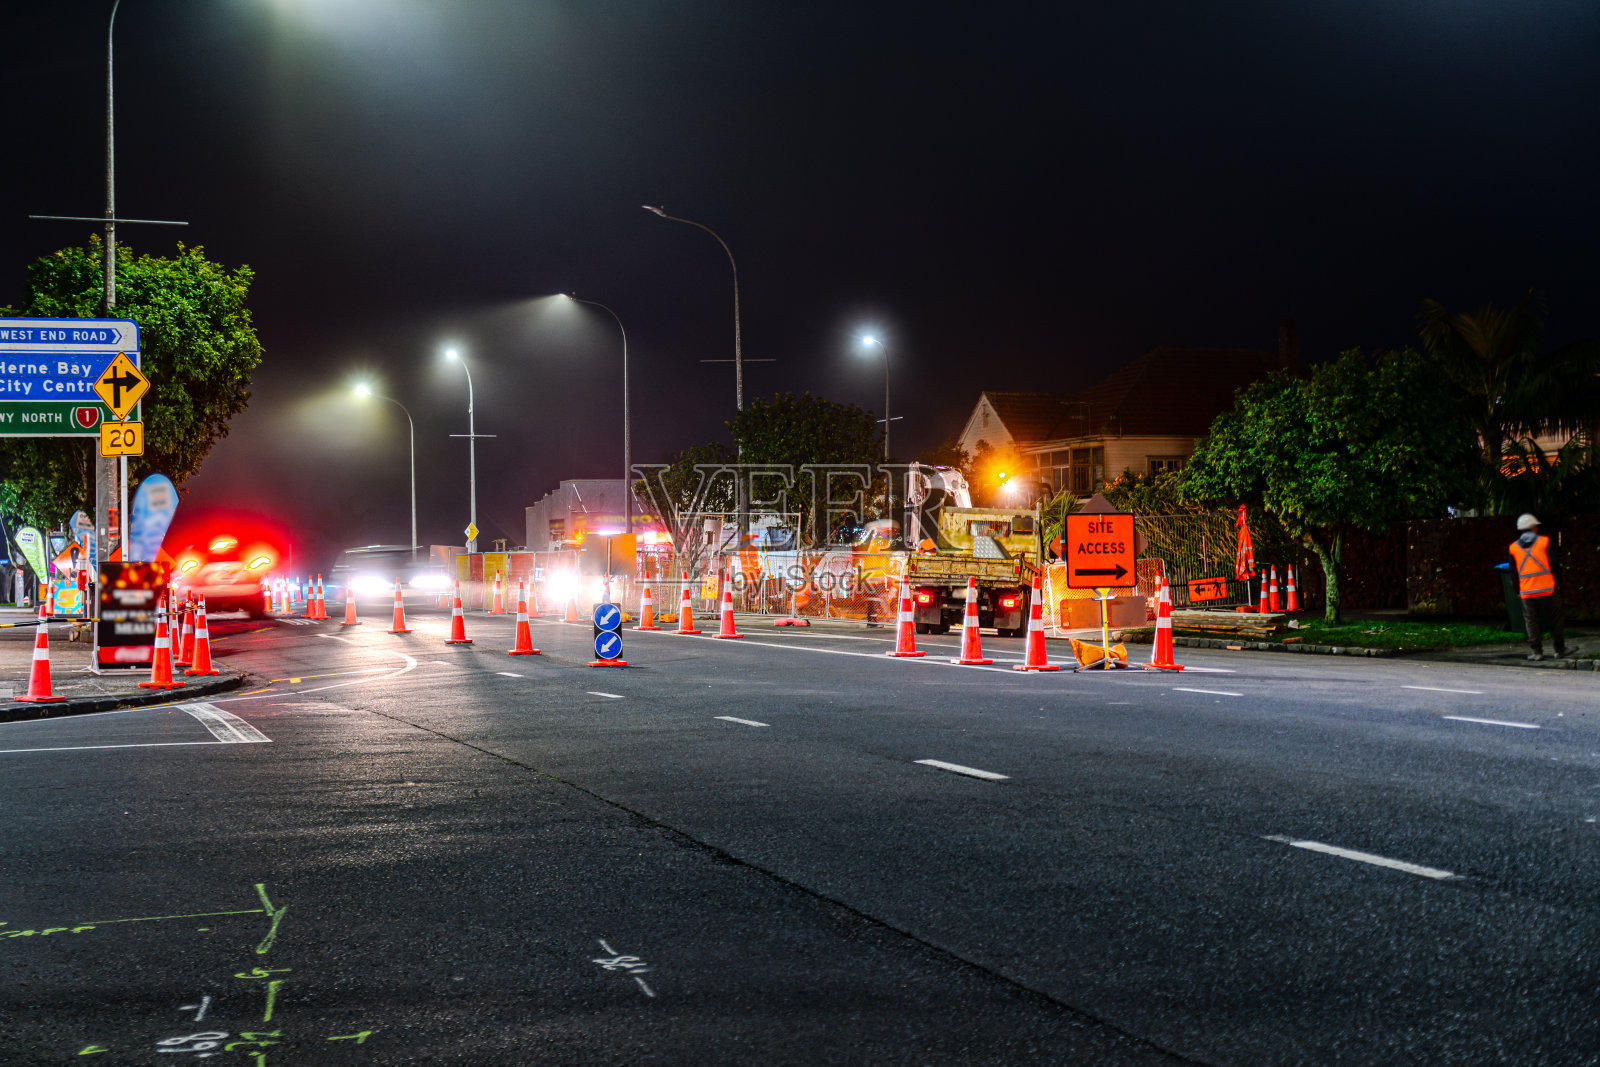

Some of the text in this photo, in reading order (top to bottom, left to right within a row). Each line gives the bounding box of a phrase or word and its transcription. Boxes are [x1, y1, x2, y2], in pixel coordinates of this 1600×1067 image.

[0, 330, 107, 341] WEST END ROAD
[57, 362, 92, 378] Bay
[43, 380, 94, 392] Centr
[22, 413, 62, 423] NORTH
[110, 429, 136, 448] 20
[1088, 522, 1113, 533] SITE
[1078, 543, 1125, 554] ACCESS
